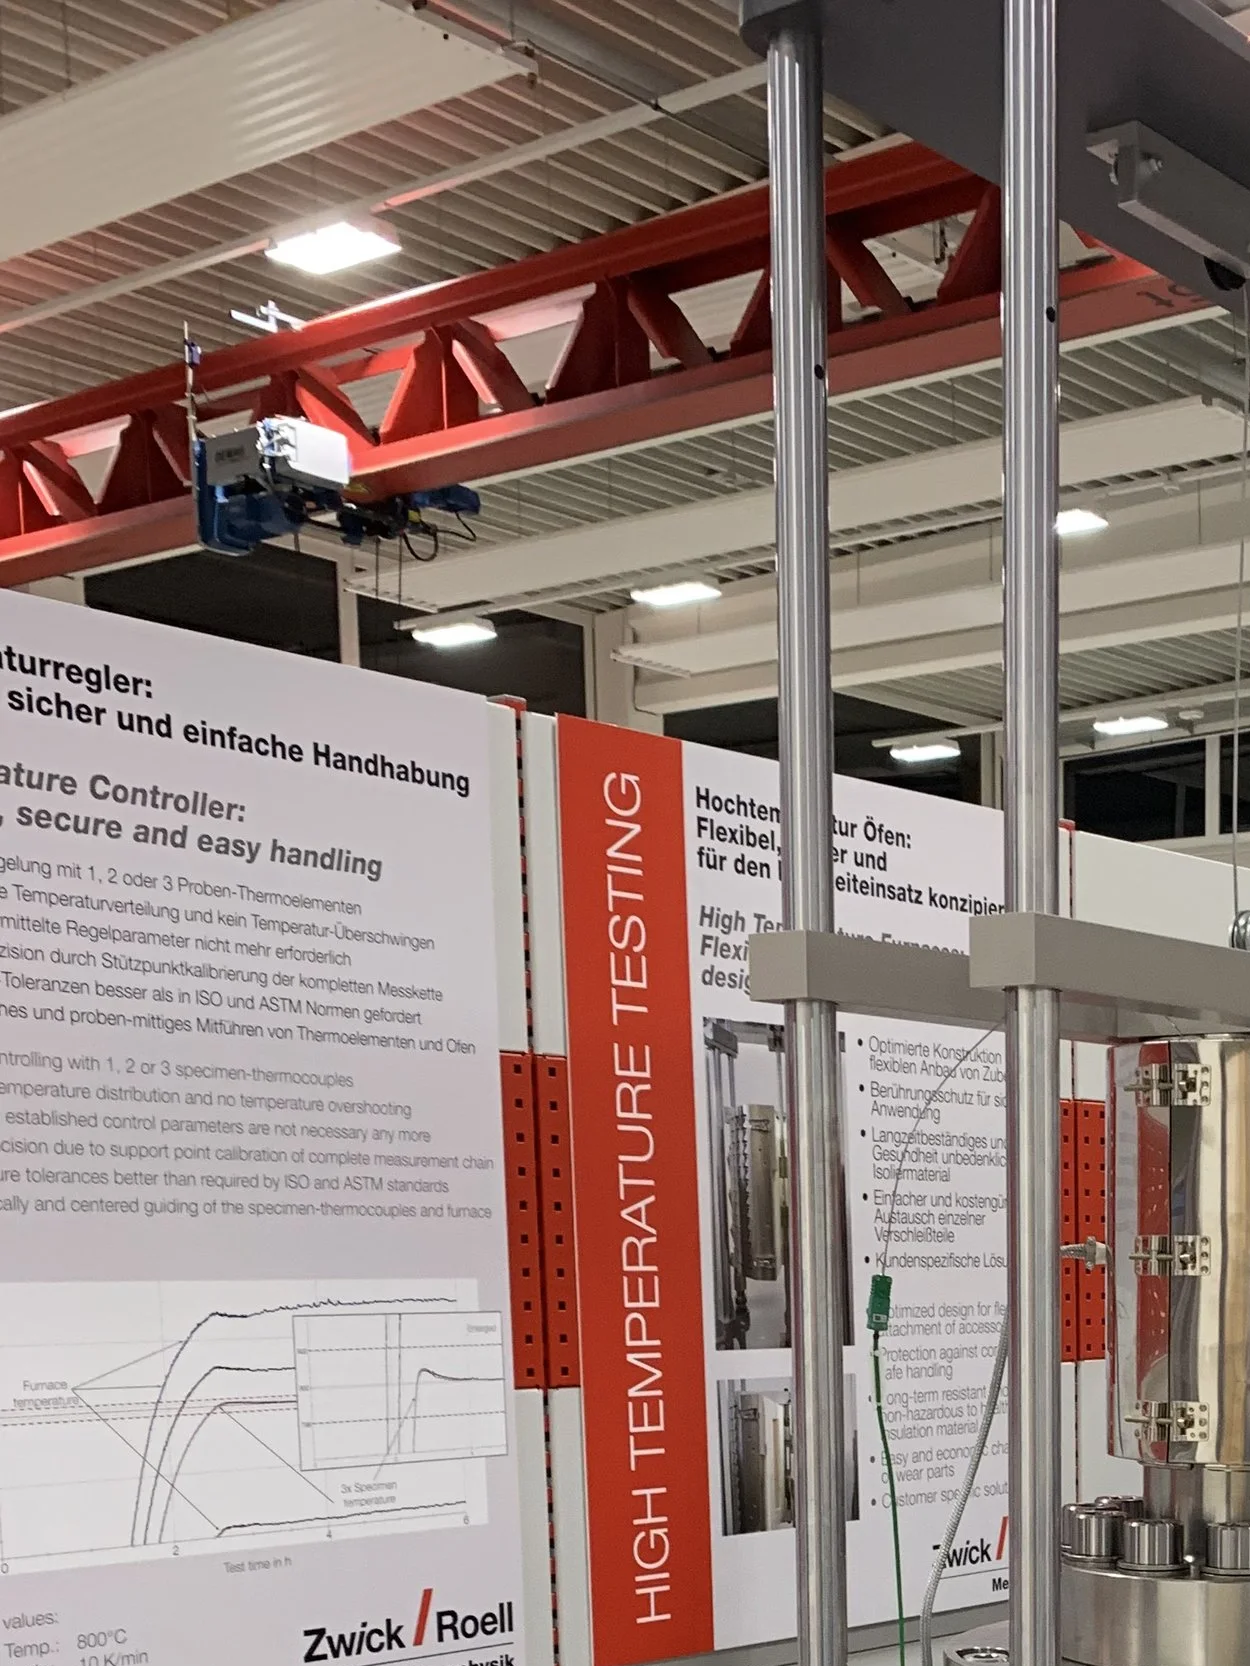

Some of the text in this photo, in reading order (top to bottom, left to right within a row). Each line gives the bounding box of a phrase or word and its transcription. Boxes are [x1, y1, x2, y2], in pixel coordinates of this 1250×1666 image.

[8, 686, 469, 797] sicher und einfache Handhabung
[89, 774, 245, 822] Controller:
[16, 806, 382, 881] secure and easy handling
[863, 815, 912, 849] Öfen:
[854, 851, 887, 872] und
[56, 862, 82, 879] mit
[108, 867, 118, 884] 2
[122, 872, 158, 888] oder
[163, 875, 173, 891] 3
[697, 846, 727, 872] für
[734, 853, 771, 879] den
[928, 886, 1005, 916] konzipier
[184, 909, 213, 924] und
[217, 910, 246, 928] kein
[699, 904, 746, 935] High
[66, 919, 351, 966] Regelparameter nicht mehr erforderlich
[49, 948, 96, 966] durch
[272, 971, 294, 986] der
[299, 973, 374, 994] kompletten
[94, 980, 147, 1000] besser
[152, 987, 173, 1002] als
[178, 989, 190, 1003] in
[195, 989, 222, 1007] ISO
[227, 995, 254, 1009] und
[258, 996, 302, 1014] ASTM
[869, 1035, 1002, 1065] Optimierte Konstruktion
[67, 1055, 100, 1070] with
[125, 1057, 135, 1073] 2
[140, 1062, 156, 1074] or
[160, 1060, 171, 1076] 3
[869, 1055, 980, 1080] flexiblen Anbau von
[95, 1085, 180, 1103] distribution
[184, 1091, 213, 1106] and
[217, 1094, 236, 1106] no
[240, 1094, 324, 1112] temperature
[870, 1080, 991, 1106] Berührungsschutz für
[5, 1109, 98, 1127] established
[102, 1115, 156, 1130] control
[160, 1119, 244, 1134] parameters
[248, 1123, 270, 1135] are
[274, 1122, 296, 1136] not
[871, 1099, 941, 1125] Anwendung
[53, 1139, 84, 1156] due
[88, 1141, 105, 1156] to
[110, 1144, 170, 1160] support
[174, 1146, 210, 1161] point
[215, 1146, 287, 1162] calibration
[290, 1148, 304, 1163] of
[872, 1125, 988, 1151] Langzeitbeständiges
[872, 1144, 938, 1164] Gesundheit
[25, 1167, 109, 1184] tolerances
[113, 1168, 158, 1185] better
[163, 1171, 196, 1186] than
[200, 1174, 259, 1190] required
[262, 1174, 280, 1192] by
[284, 1174, 310, 1189] ISO
[872, 1162, 951, 1182] Isoliermaterial
[34, 1196, 66, 1211] and
[70, 1197, 139, 1213] centered
[144, 1199, 199, 1217] guiding
[202, 1199, 216, 1214] of
[220, 1200, 244, 1214] the
[603, 771, 671, 1624] HIGH TEMPERATURE TESTING
[873, 1188, 952, 1207] Einfacher und
[874, 1207, 986, 1226] Austausch einzelner
[874, 1226, 955, 1243] Verschleißteile
[875, 1252, 980, 1271] Kundenspezifische
[906, 1363, 954, 1381] handling
[911, 1449, 933, 1463] and
[927, 1464, 955, 1482] parts
[2, 1612, 60, 1630] values:
[303, 1602, 514, 1664] Zwick Roell
[4, 1628, 128, 1658] Temp.: 800°C
